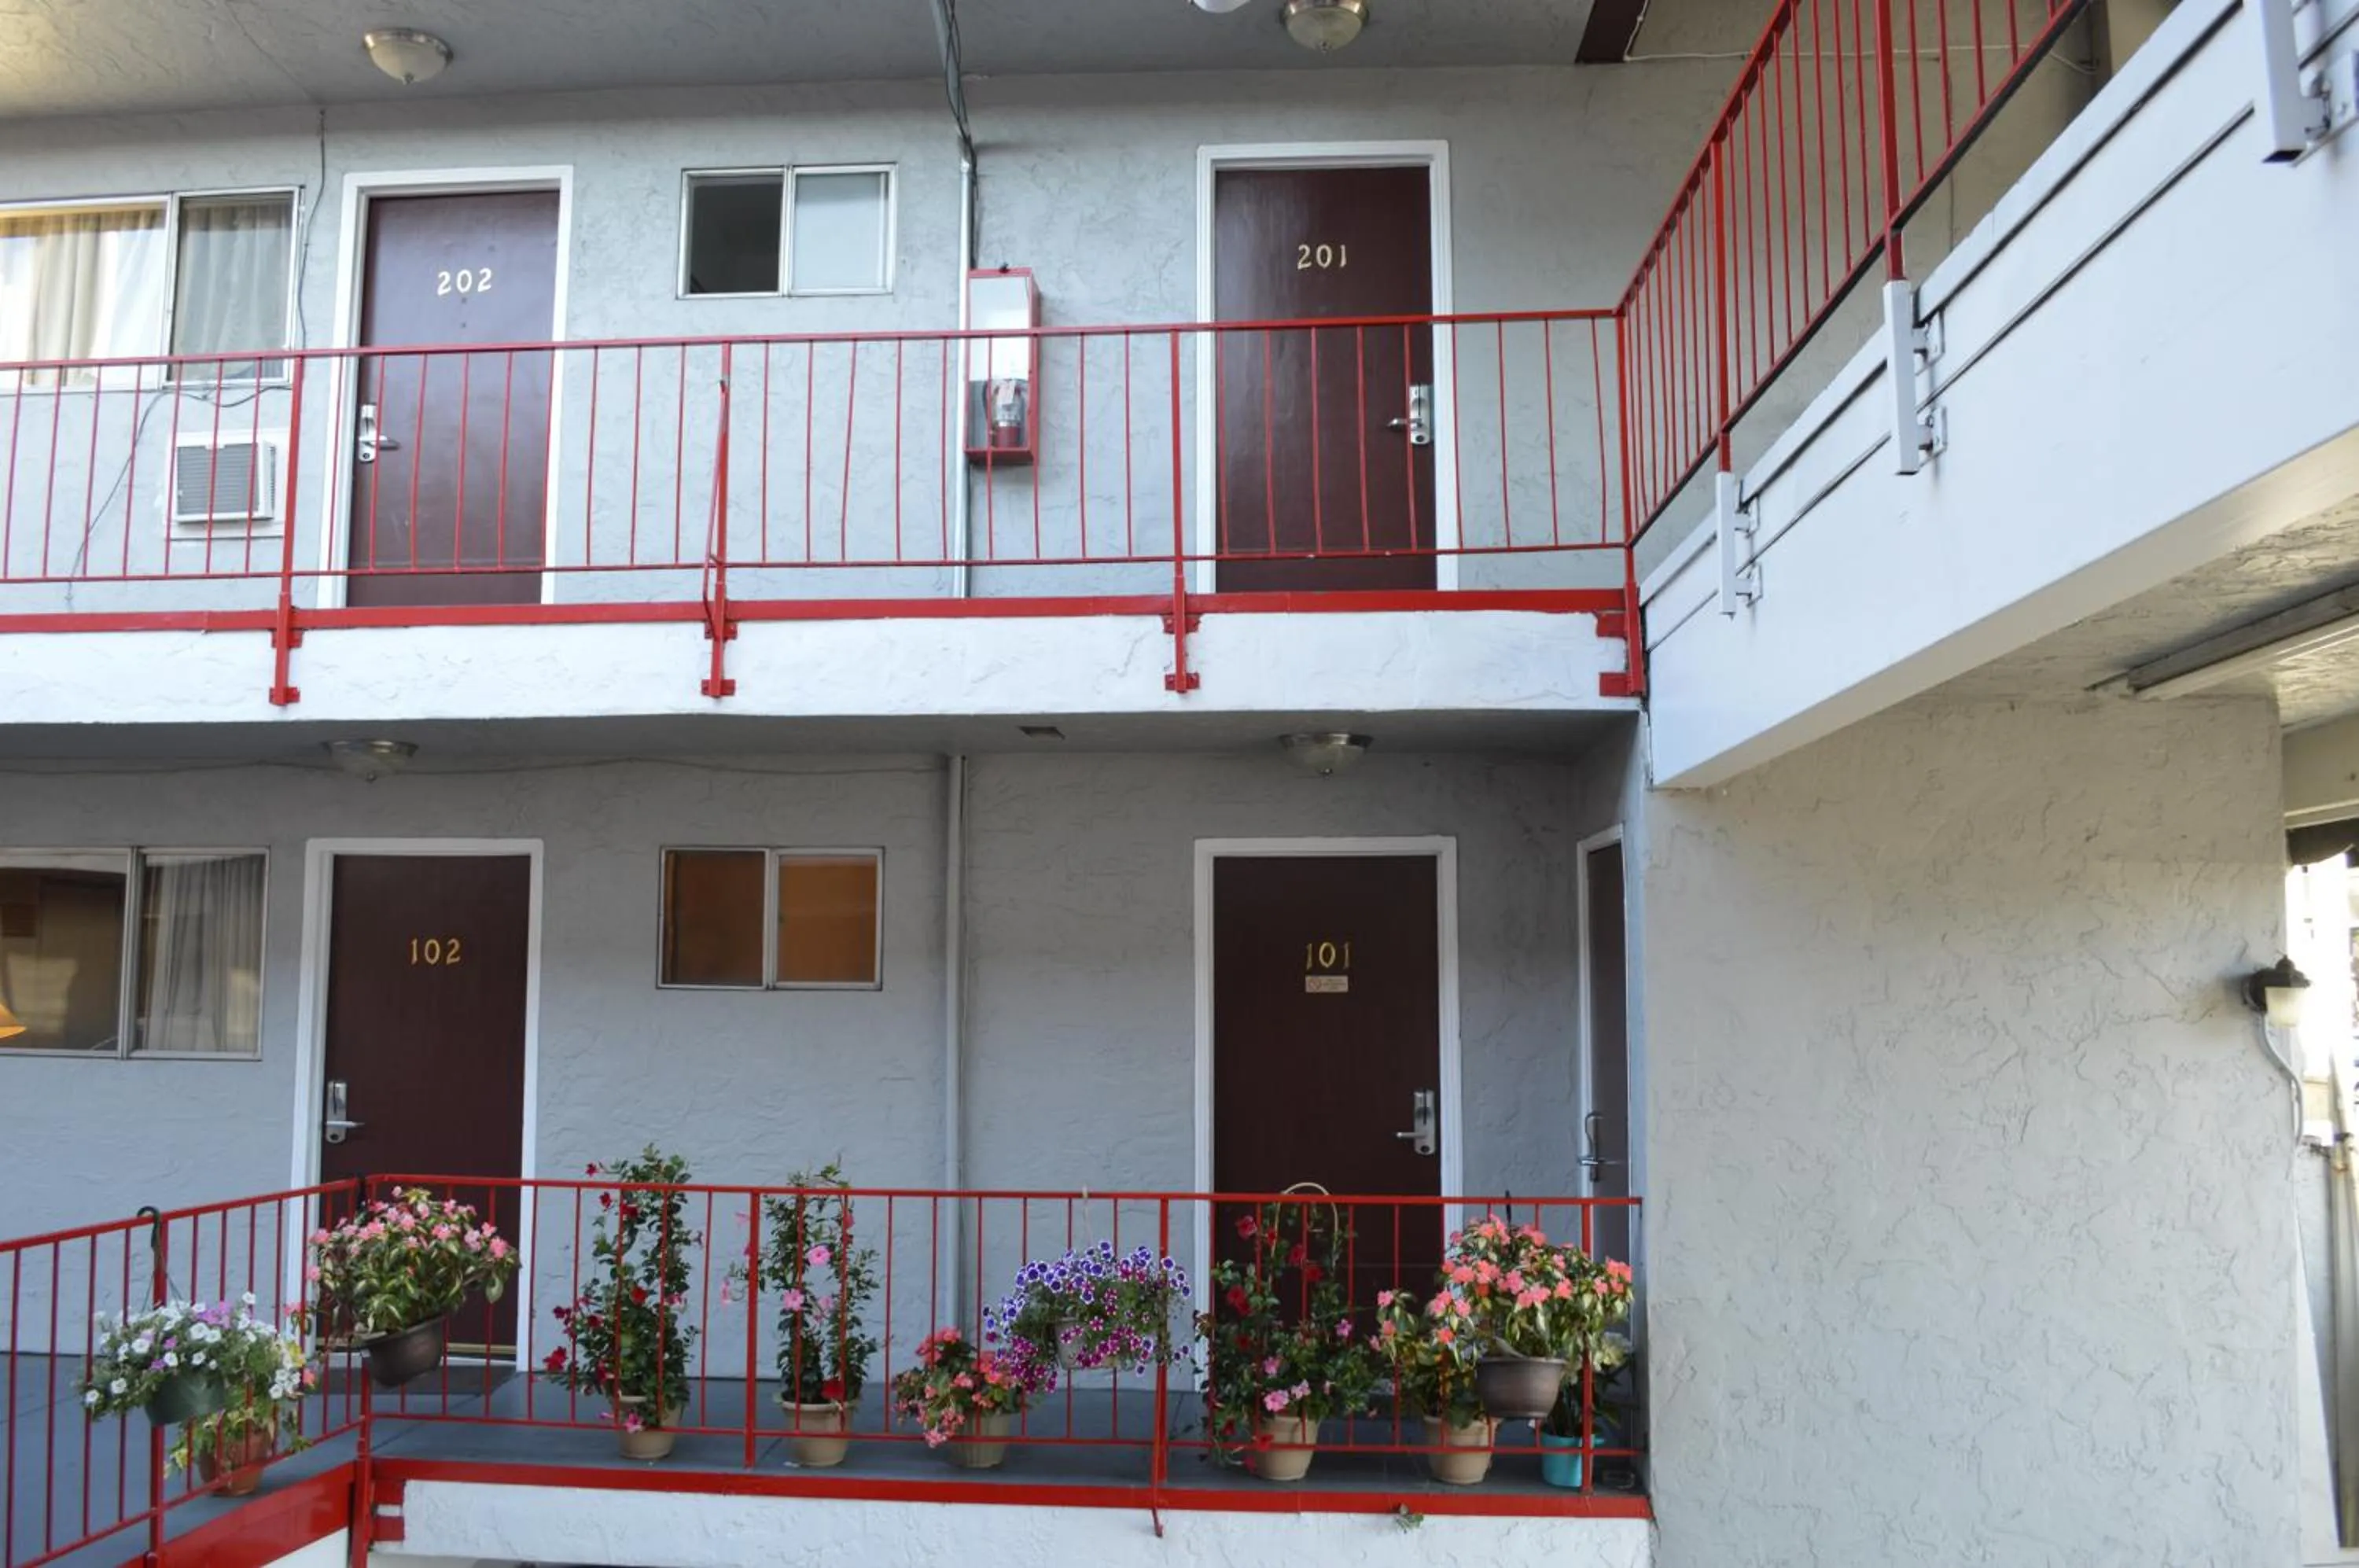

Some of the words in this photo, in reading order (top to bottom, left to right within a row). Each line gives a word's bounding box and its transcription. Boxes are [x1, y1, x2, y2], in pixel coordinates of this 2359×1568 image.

[1297, 244, 1347, 271] 201
[437, 267, 492, 296] 202
[410, 937, 462, 966] 102
[1306, 942, 1350, 970] 101
